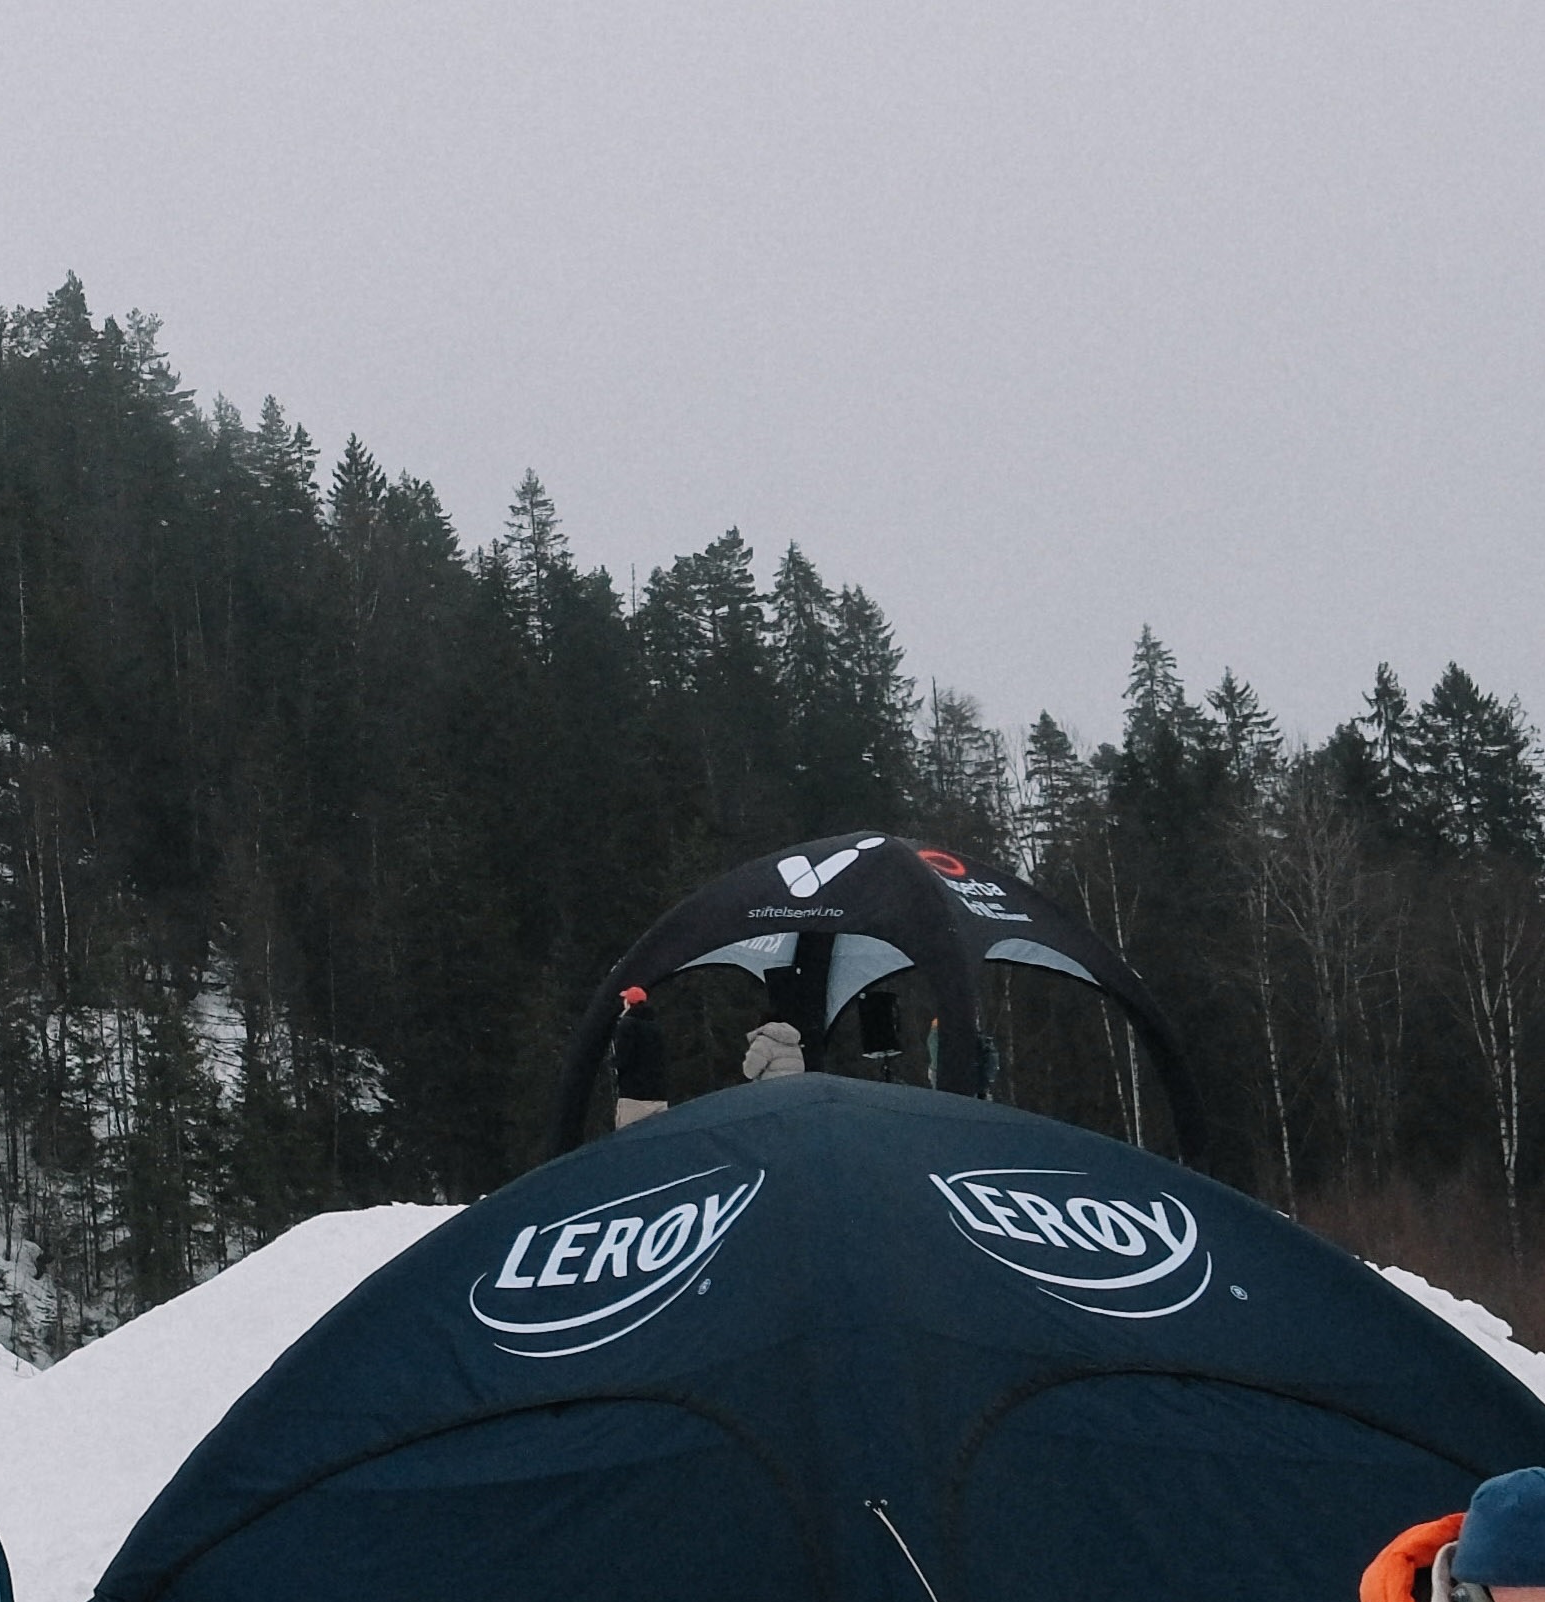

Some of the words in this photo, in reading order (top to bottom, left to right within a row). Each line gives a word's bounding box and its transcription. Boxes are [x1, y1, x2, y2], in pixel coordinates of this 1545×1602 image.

[748, 904, 844, 919] stiftelsenvi.no
[495, 1184, 748, 1289] LERØY
[928, 1173, 1189, 1256] LERØY
